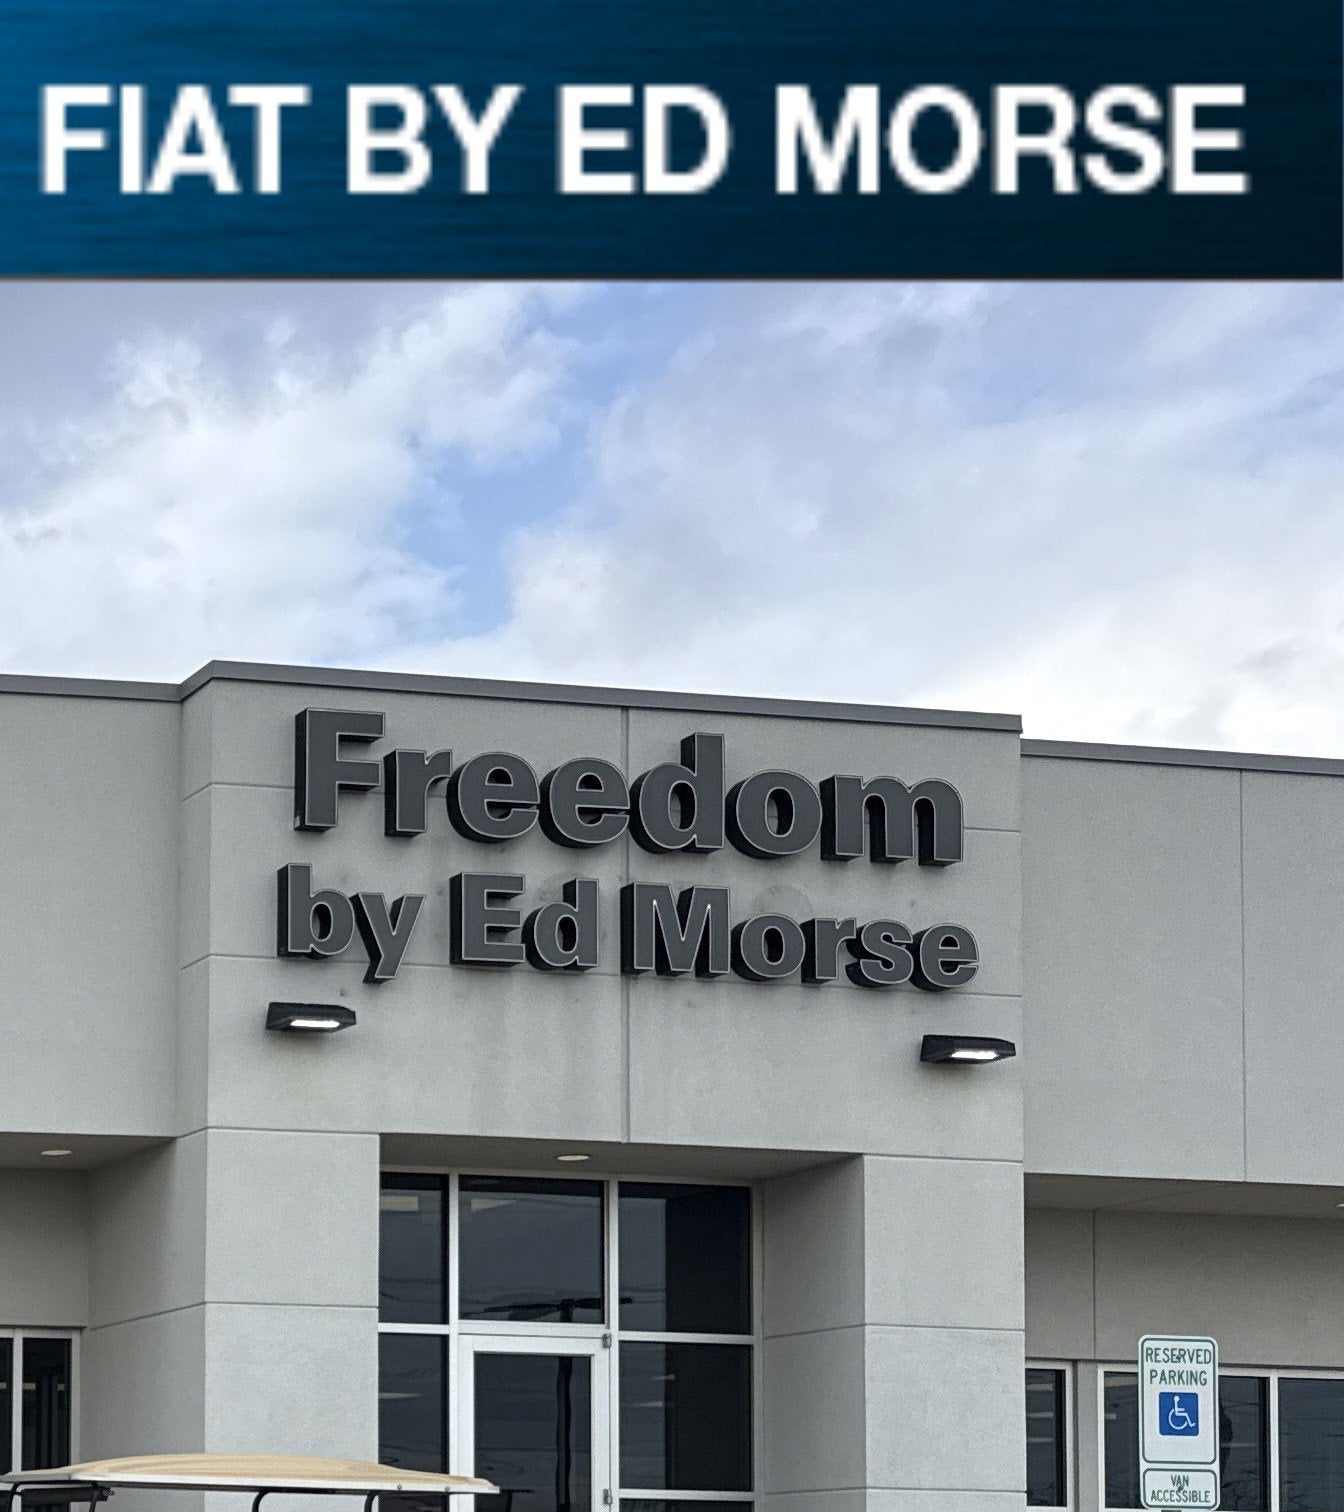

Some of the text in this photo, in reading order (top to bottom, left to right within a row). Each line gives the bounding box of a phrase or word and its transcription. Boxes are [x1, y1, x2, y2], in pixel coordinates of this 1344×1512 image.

[295, 707, 965, 867] Freedom
[277, 862, 980, 992] by Ed Morse
[1145, 1347, 1212, 1365] RESERVED
[1149, 1368, 1208, 1386] PARKING
[1170, 1474, 1190, 1488] VAN
[1150, 1489, 1211, 1504] ACCESSIBLE
